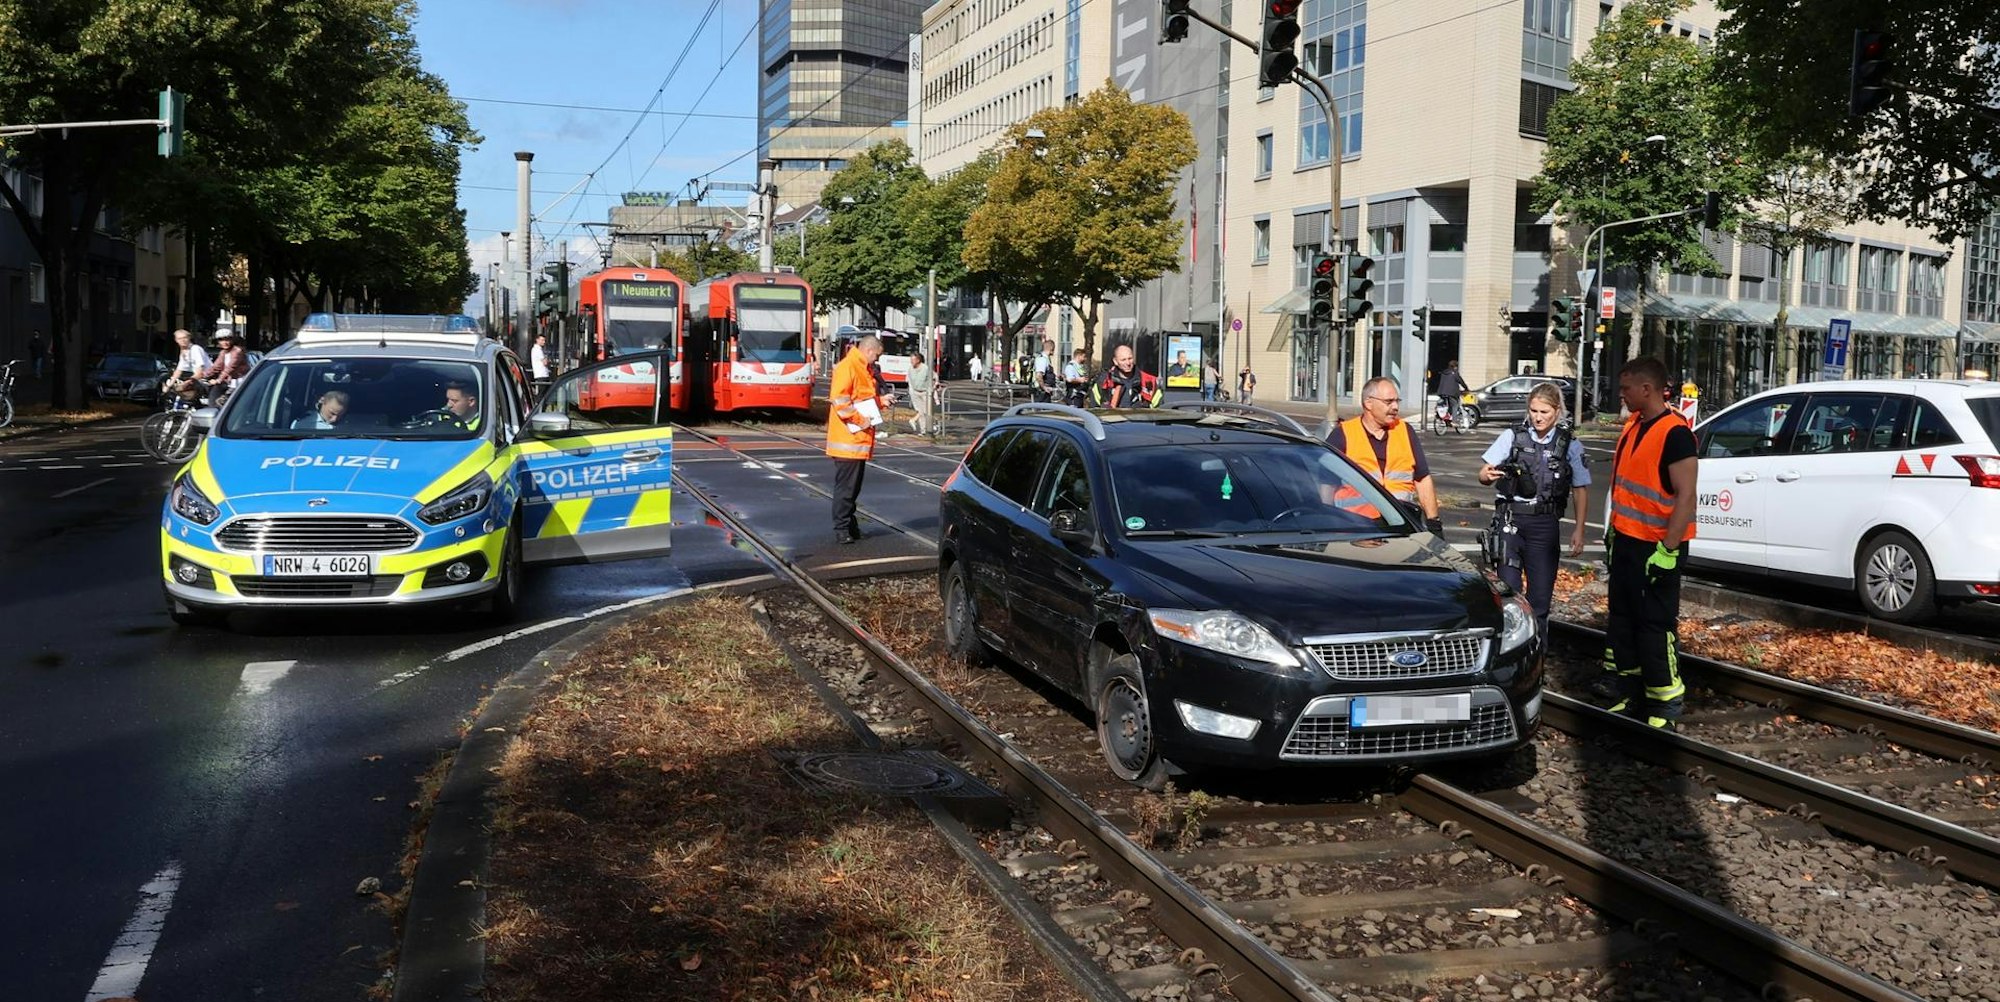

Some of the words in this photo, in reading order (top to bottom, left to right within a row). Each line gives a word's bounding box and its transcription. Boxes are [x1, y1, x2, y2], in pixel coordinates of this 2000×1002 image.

[613, 284, 617, 295] 1
[621, 284, 671, 297] Neumarkt
[260, 455, 400, 470] POLIZEI
[531, 462, 629, 491] POLIZEI
[1699, 493, 1719, 506] KVB
[1696, 514, 1753, 528] IEBSAUFSICHT
[274, 557, 303, 573] NRW
[312, 557, 321, 573] 4
[329, 557, 367, 573] 6026
